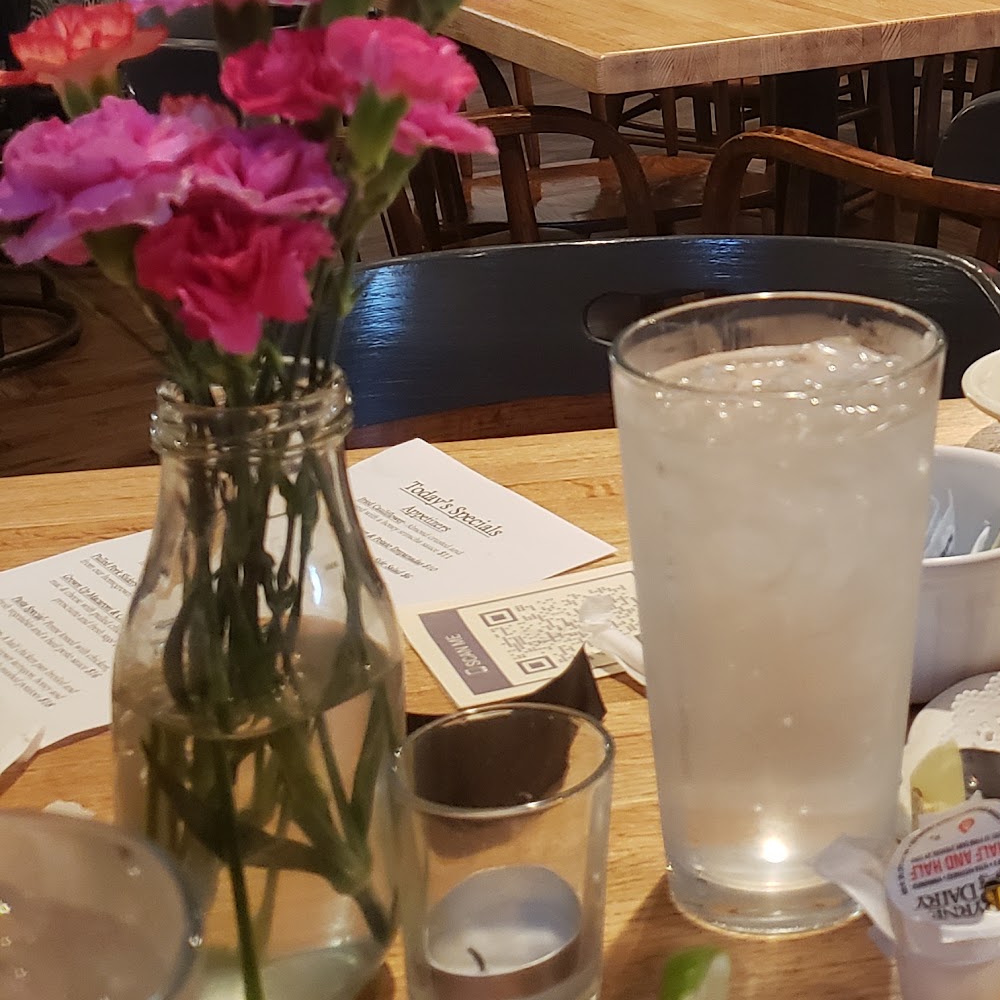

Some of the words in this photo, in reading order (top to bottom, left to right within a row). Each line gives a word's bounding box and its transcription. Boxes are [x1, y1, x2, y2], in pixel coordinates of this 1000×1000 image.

[404, 480, 453, 509] Today's
[449, 505, 504, 537] Specials
[445, 633, 467, 647] ME
[455, 646, 481, 667] SCAN
[911, 859, 943, 881] HALF
[944, 850, 971, 870] AND
[917, 882, 978, 909] DAIRY
